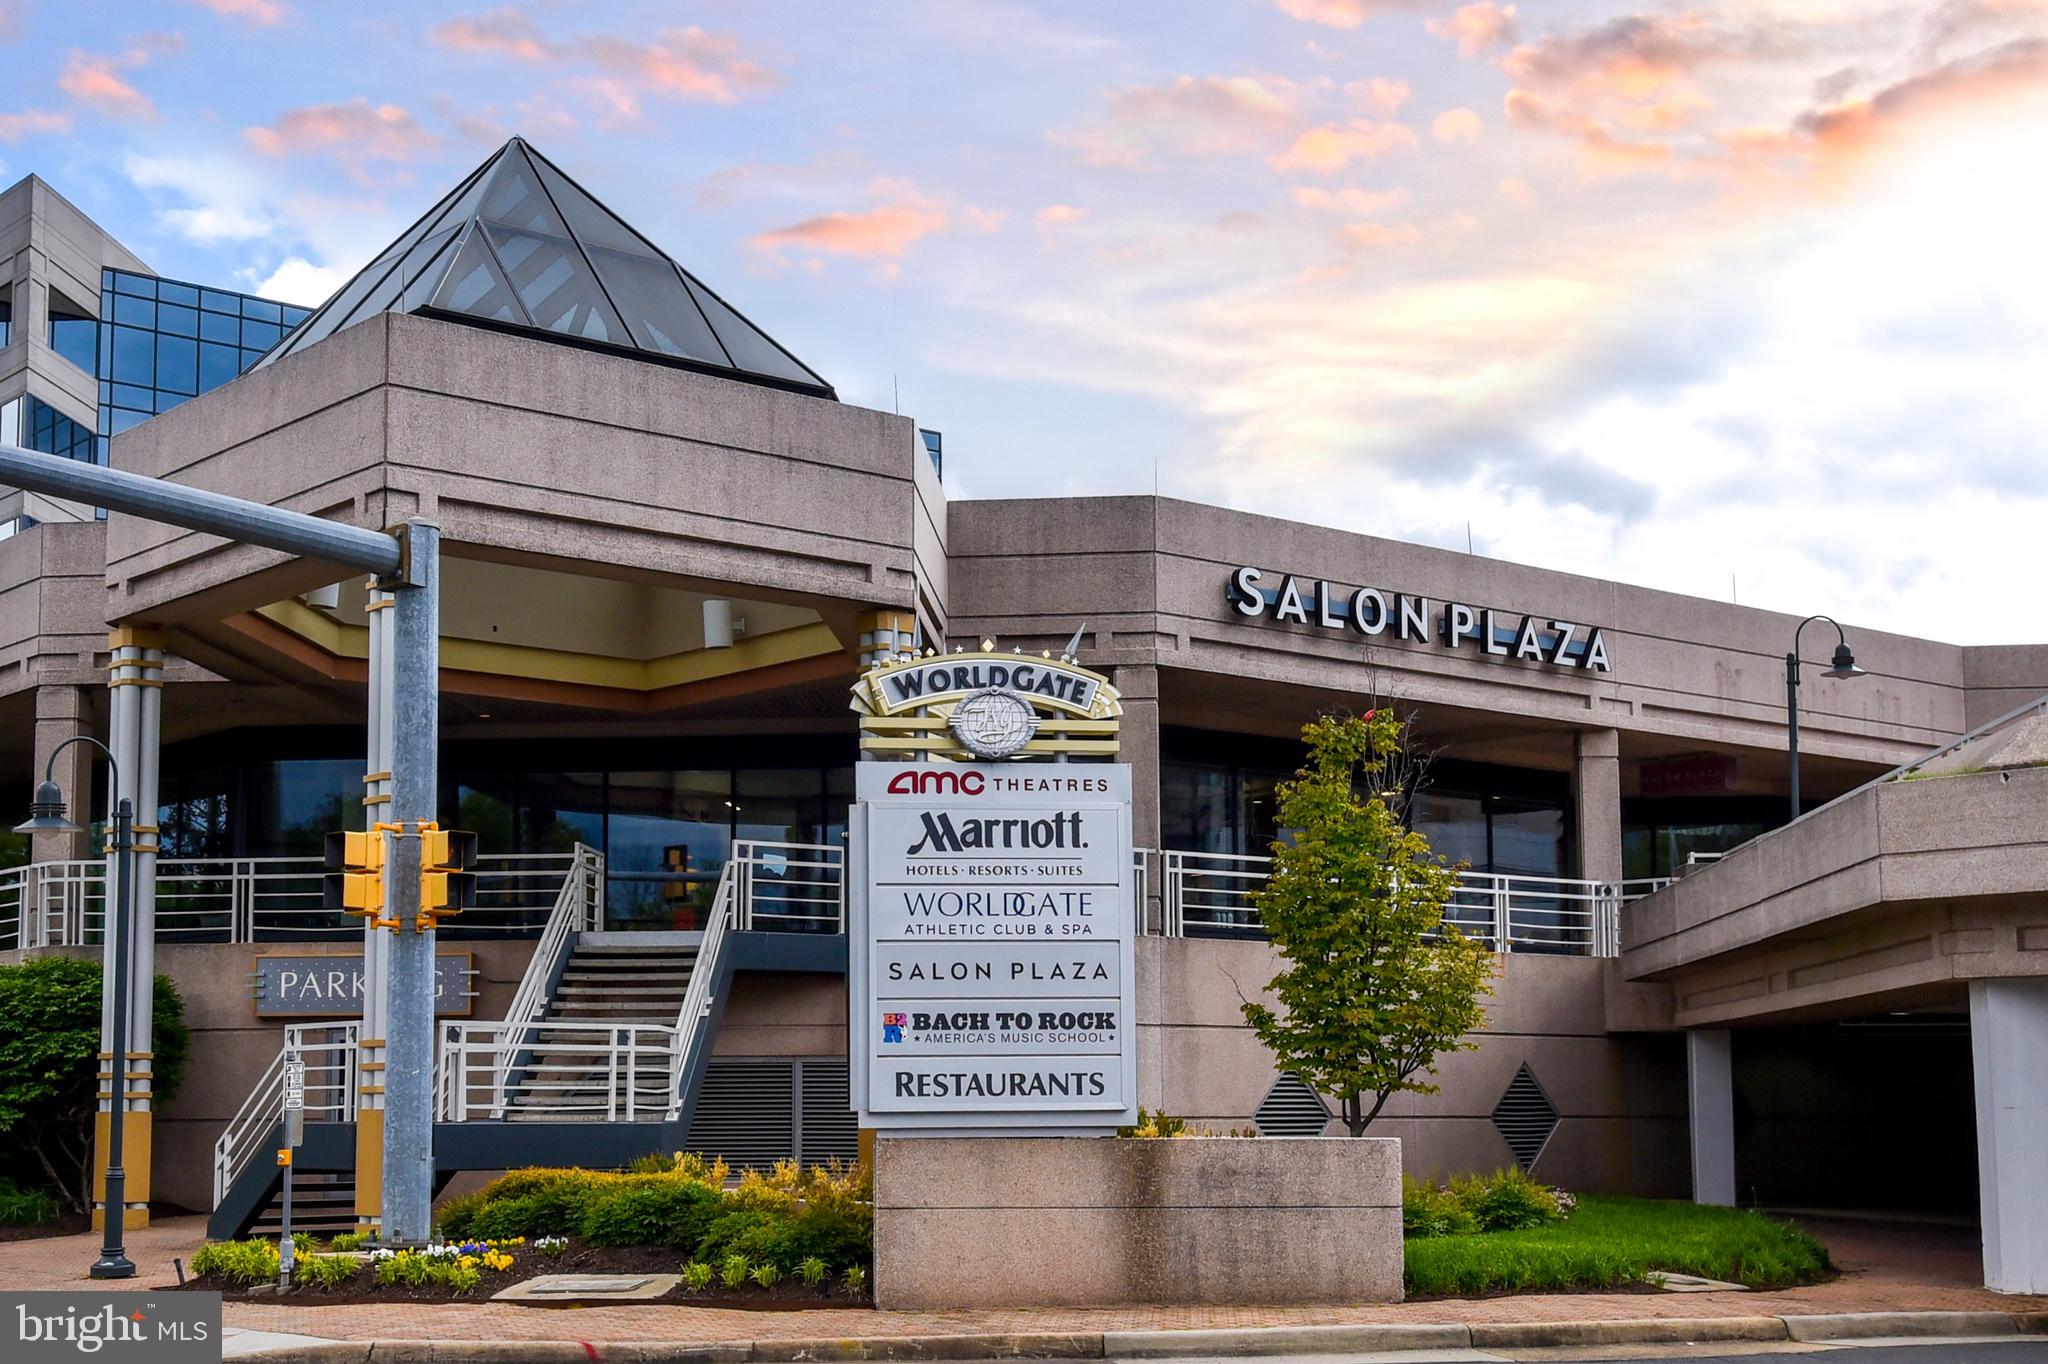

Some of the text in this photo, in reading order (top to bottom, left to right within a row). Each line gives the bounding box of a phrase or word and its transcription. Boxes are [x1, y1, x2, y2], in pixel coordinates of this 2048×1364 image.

[1231, 567, 1612, 672] SALON PLAZA
[892, 665, 1088, 704] WORLDGATE
[993, 778, 1108, 792] THEATRES
[904, 892, 1093, 917] WORLDGATE
[904, 924, 1092, 935] ATHLETIC CLUB & SPA
[888, 962, 1108, 980] SALON PLAZA
[912, 1012, 1116, 1030] BACH TO ROCK
[924, 1032, 1105, 1043] AMERICA'S MUSIC SCHOOL
[895, 1072, 1105, 1097] RESTAURANTS
